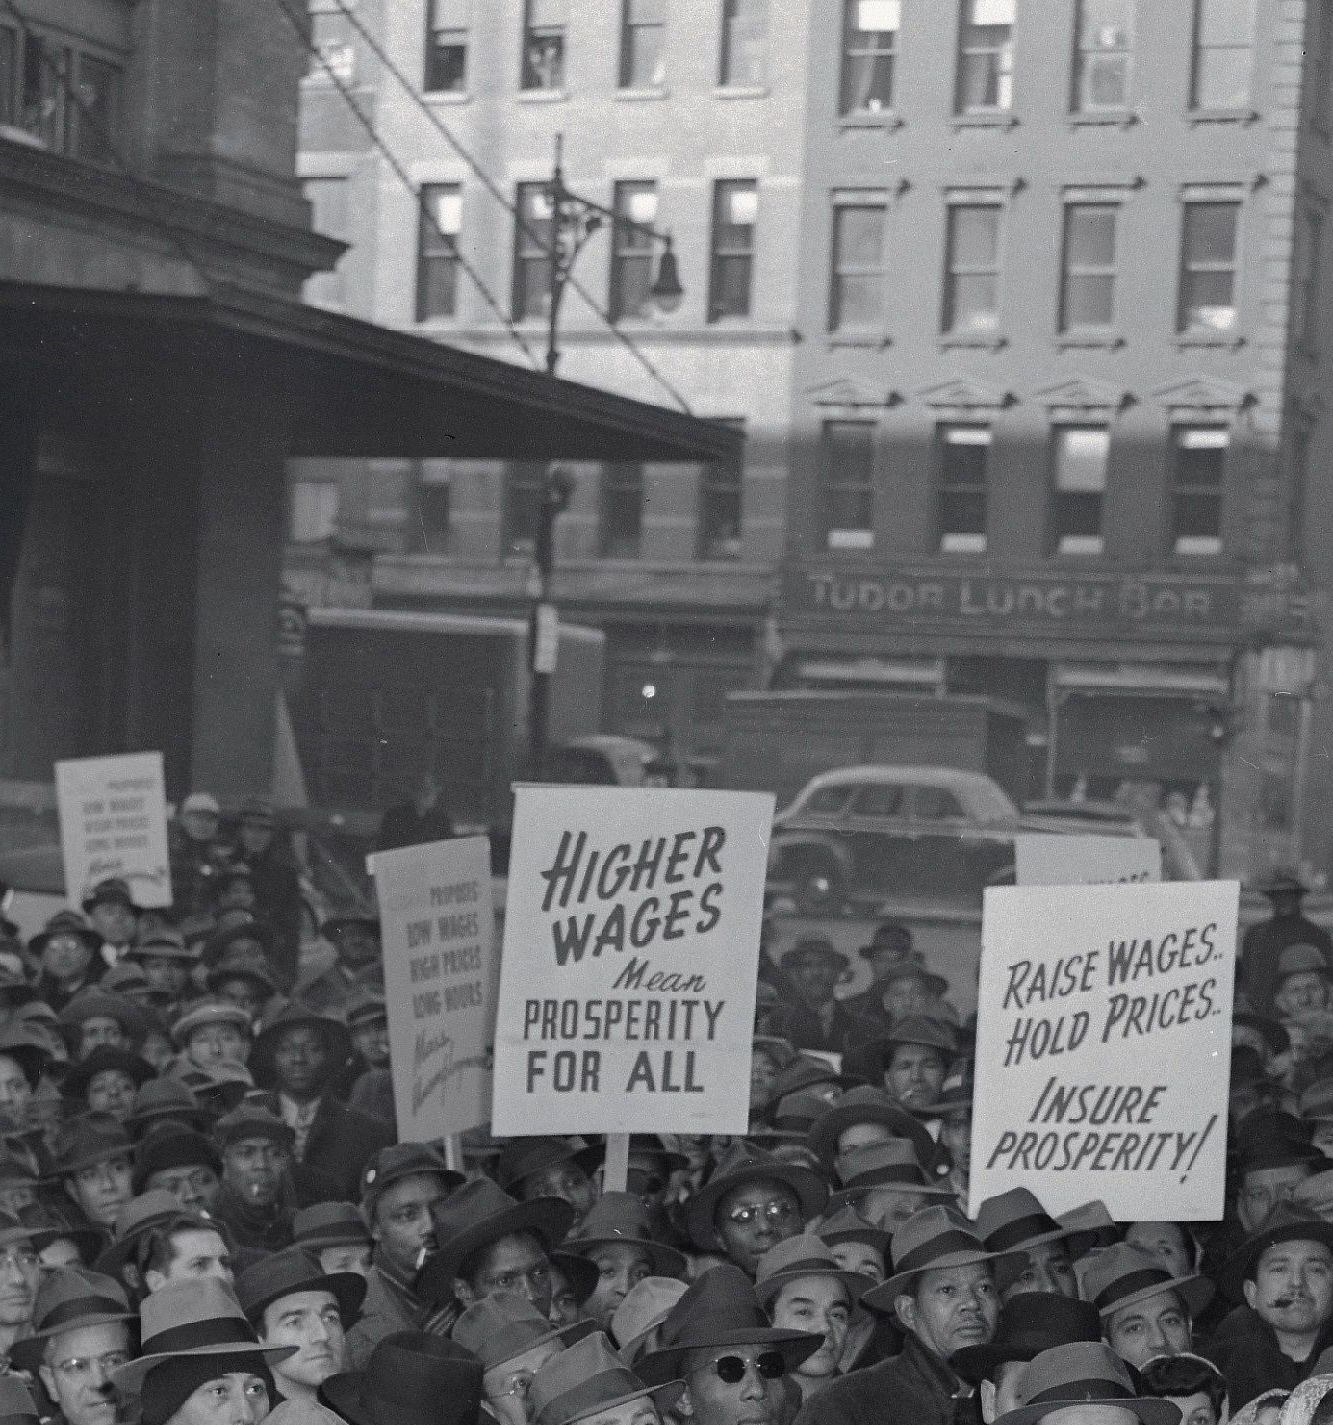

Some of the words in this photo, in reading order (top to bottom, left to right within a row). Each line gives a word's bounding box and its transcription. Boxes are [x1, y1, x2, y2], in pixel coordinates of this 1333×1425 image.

[540, 826, 727, 912] HIGHER
[552, 882, 723, 967] WAGES
[612, 956, 706, 993] Mean
[1002, 950, 1099, 1010] RAISE
[524, 999, 725, 1041] PROSPERITY
[1003, 1010, 1090, 1068] HOLD
[526, 1050, 601, 1093] FOR
[625, 1050, 705, 1093] ALL
[1029, 1076, 1167, 1125] INSURE
[986, 1114, 1218, 1184] PROSPERITY!
